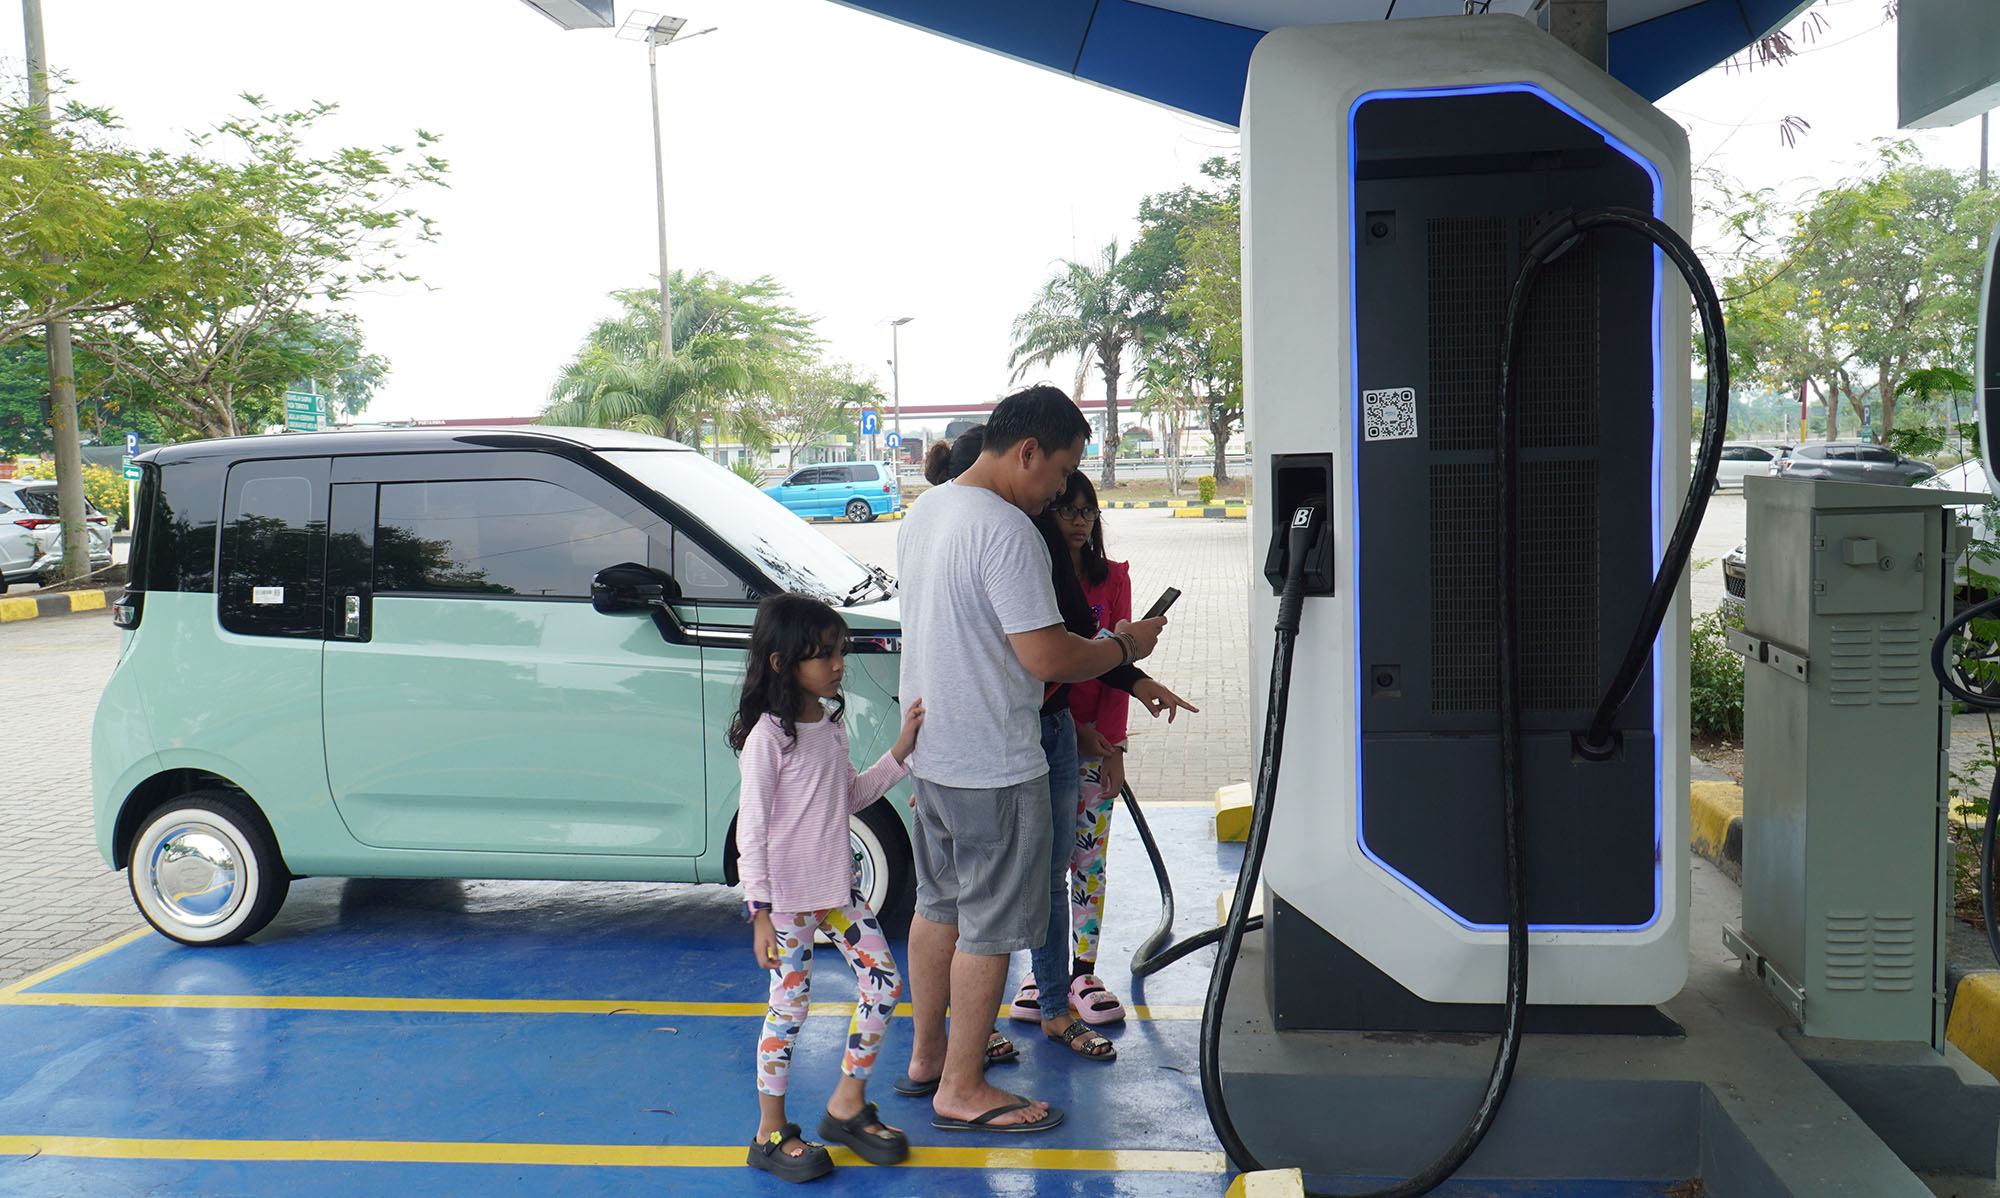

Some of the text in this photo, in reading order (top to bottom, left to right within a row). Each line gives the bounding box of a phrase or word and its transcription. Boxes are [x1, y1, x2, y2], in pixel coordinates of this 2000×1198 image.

[1864, 407, 1870, 422] P
[127, 434, 136, 453] P
[1294, 509, 1309, 525] B
